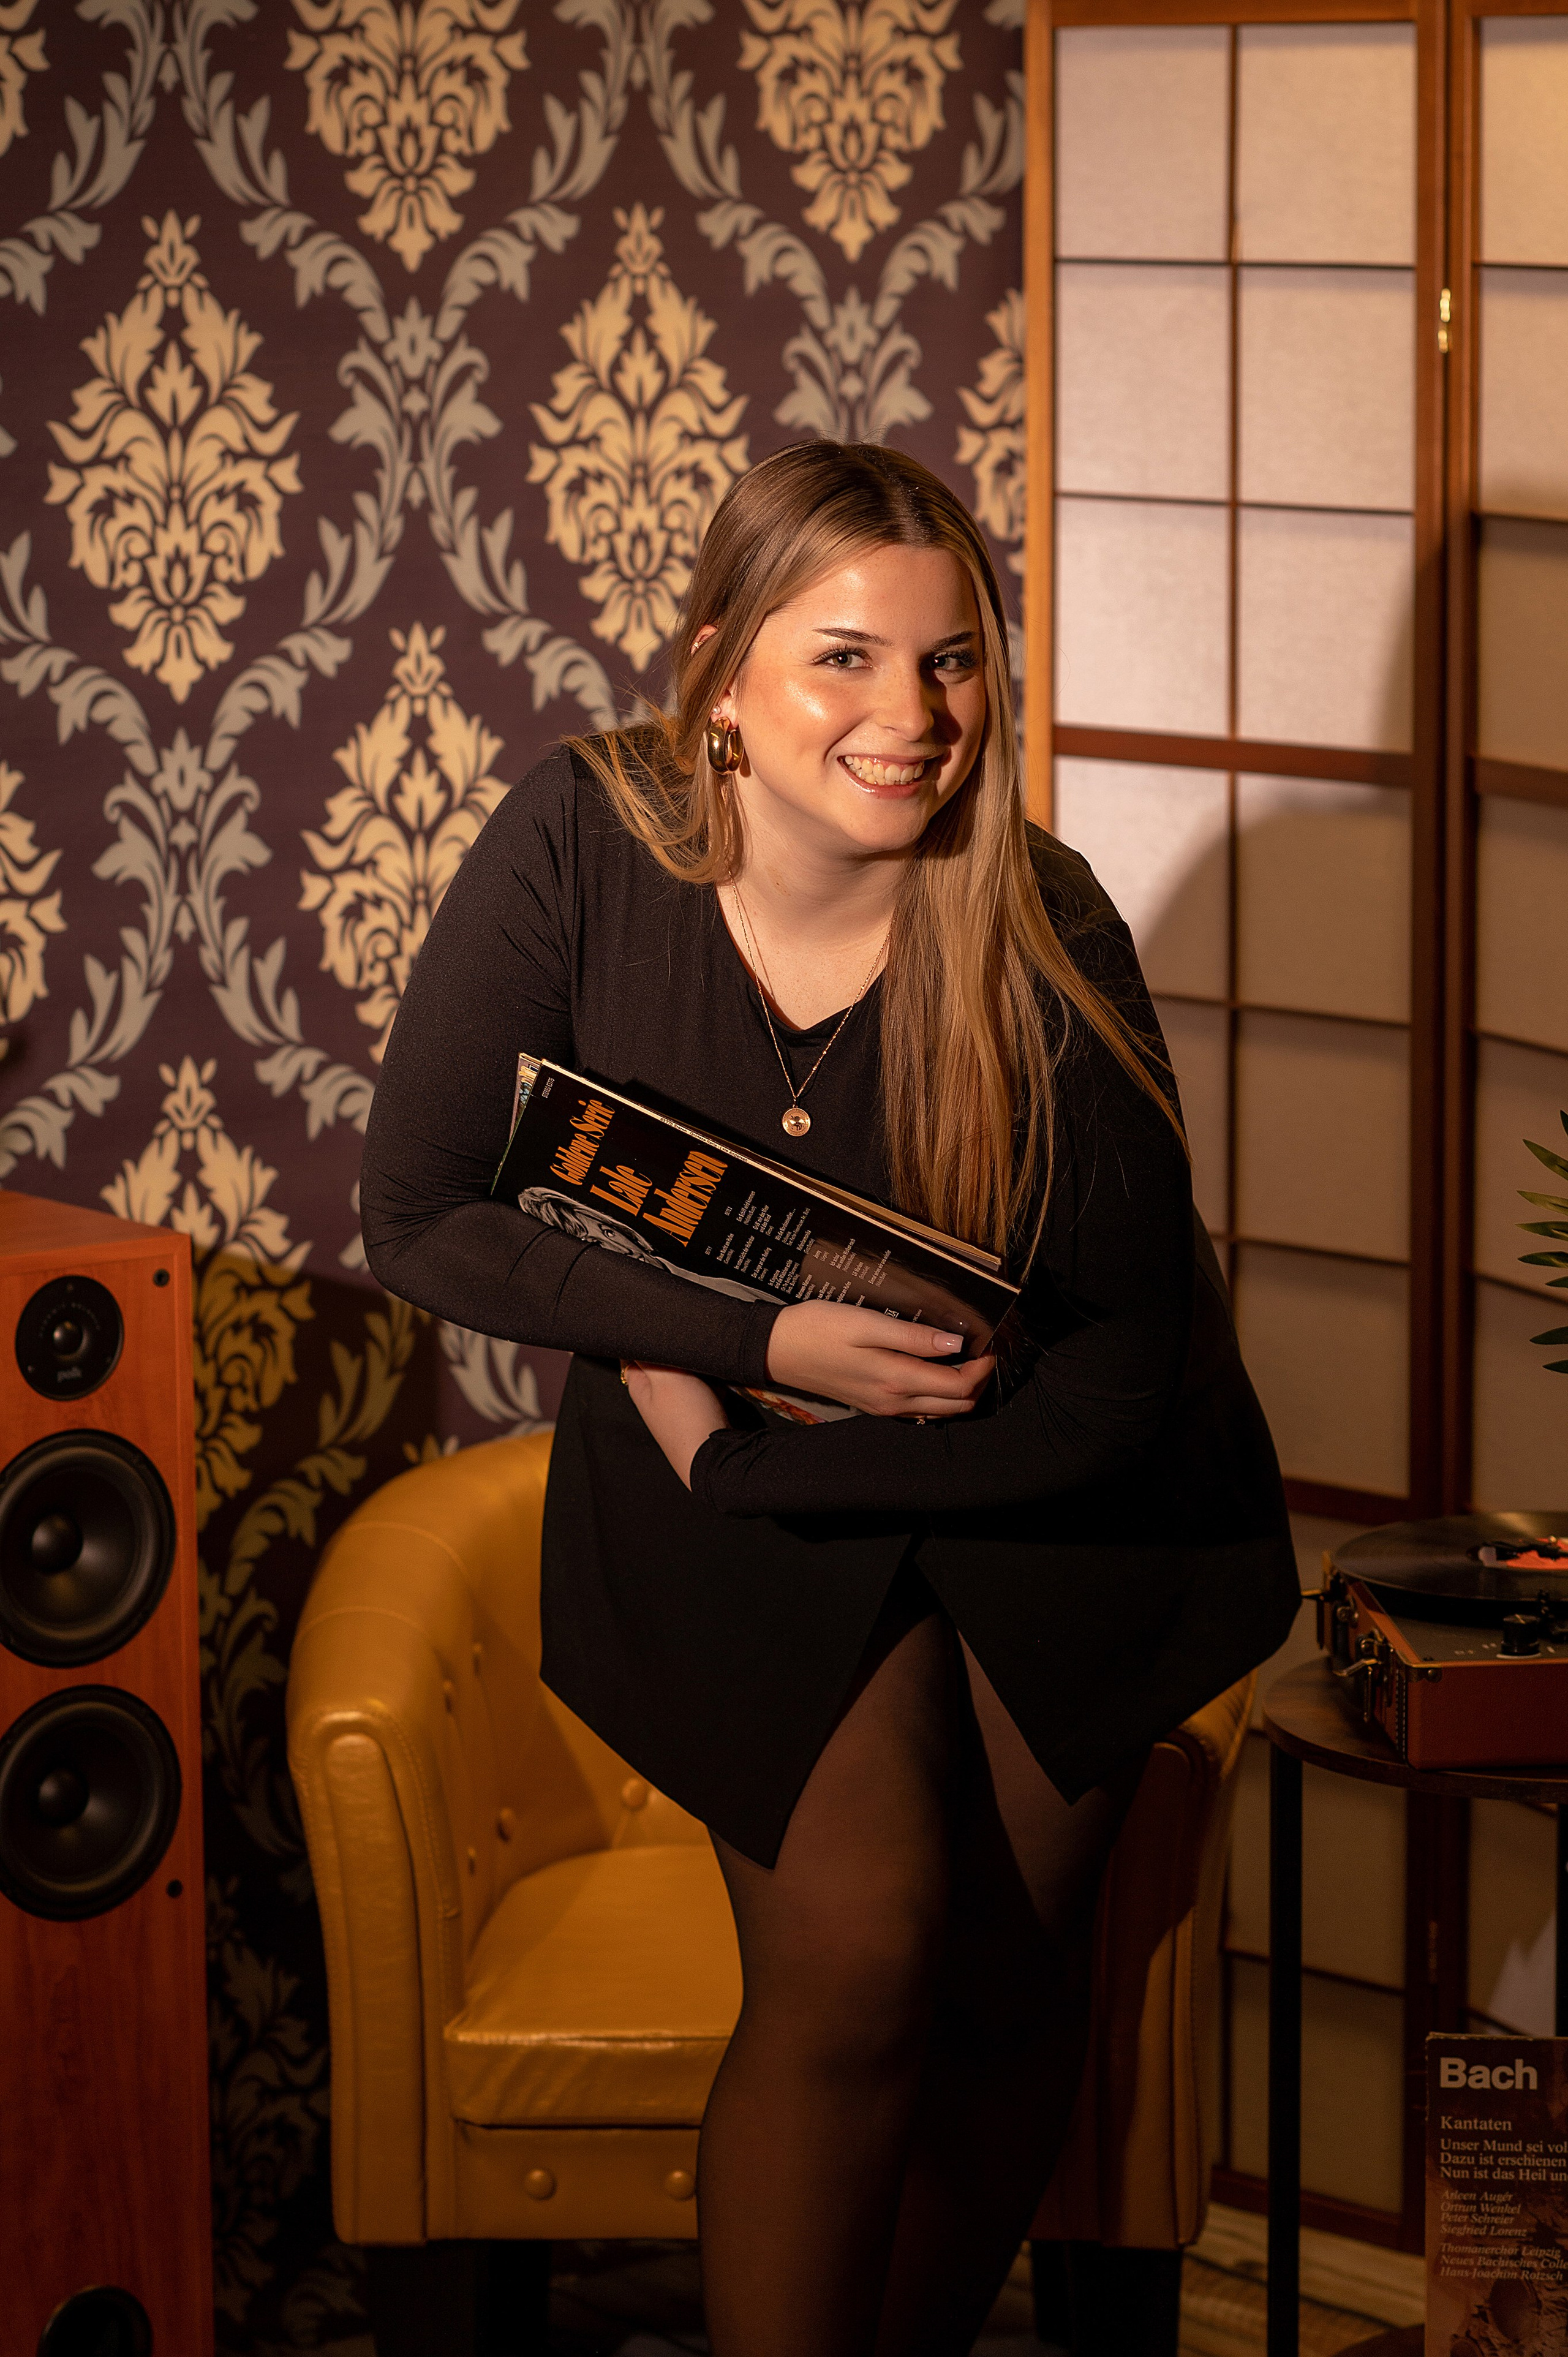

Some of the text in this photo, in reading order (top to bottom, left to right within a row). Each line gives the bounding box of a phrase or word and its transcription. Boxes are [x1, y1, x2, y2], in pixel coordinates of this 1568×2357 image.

[542, 1085, 551, 1098] STEREO
[549, 1099, 615, 1185] Goldene Serie
[590, 1165, 652, 1216] Lale
[746, 1191, 755, 1202] kommen
[643, 1151, 728, 1247] Andersen
[813, 1250, 822, 1259] Jonny
[843, 1245, 851, 1254] Wolken
[779, 1267, 788, 1278] Mädchen
[796, 1274, 812, 1299] Matrosen-Matrosen
[1440, 2057, 1537, 2090] Bach
[1441, 2116, 1512, 2131] Kantaten
[1441, 2138, 1568, 2153] Unser Mund sei vol
[1440, 2152, 1566, 2167] Dazu ist erschienen
[1440, 2167, 1469, 2178] Nun
[1474, 2167, 1488, 2179] ist
[1492, 2168, 1515, 2179] das
[1519, 2168, 1546, 2181] Heil
[1442, 2190, 1476, 2200] Arleen
[1480, 2203, 1521, 2214] Wenkel
[1441, 2212, 1515, 2224] Peter Schreier
[1440, 2224, 1528, 2236] Siegfried Lorenz
[1441, 2243, 1561, 2259] Thomanerchor Leipzig
[1441, 2255, 1474, 2265] Neues
[1477, 2256, 1538, 2268] Bachisches
